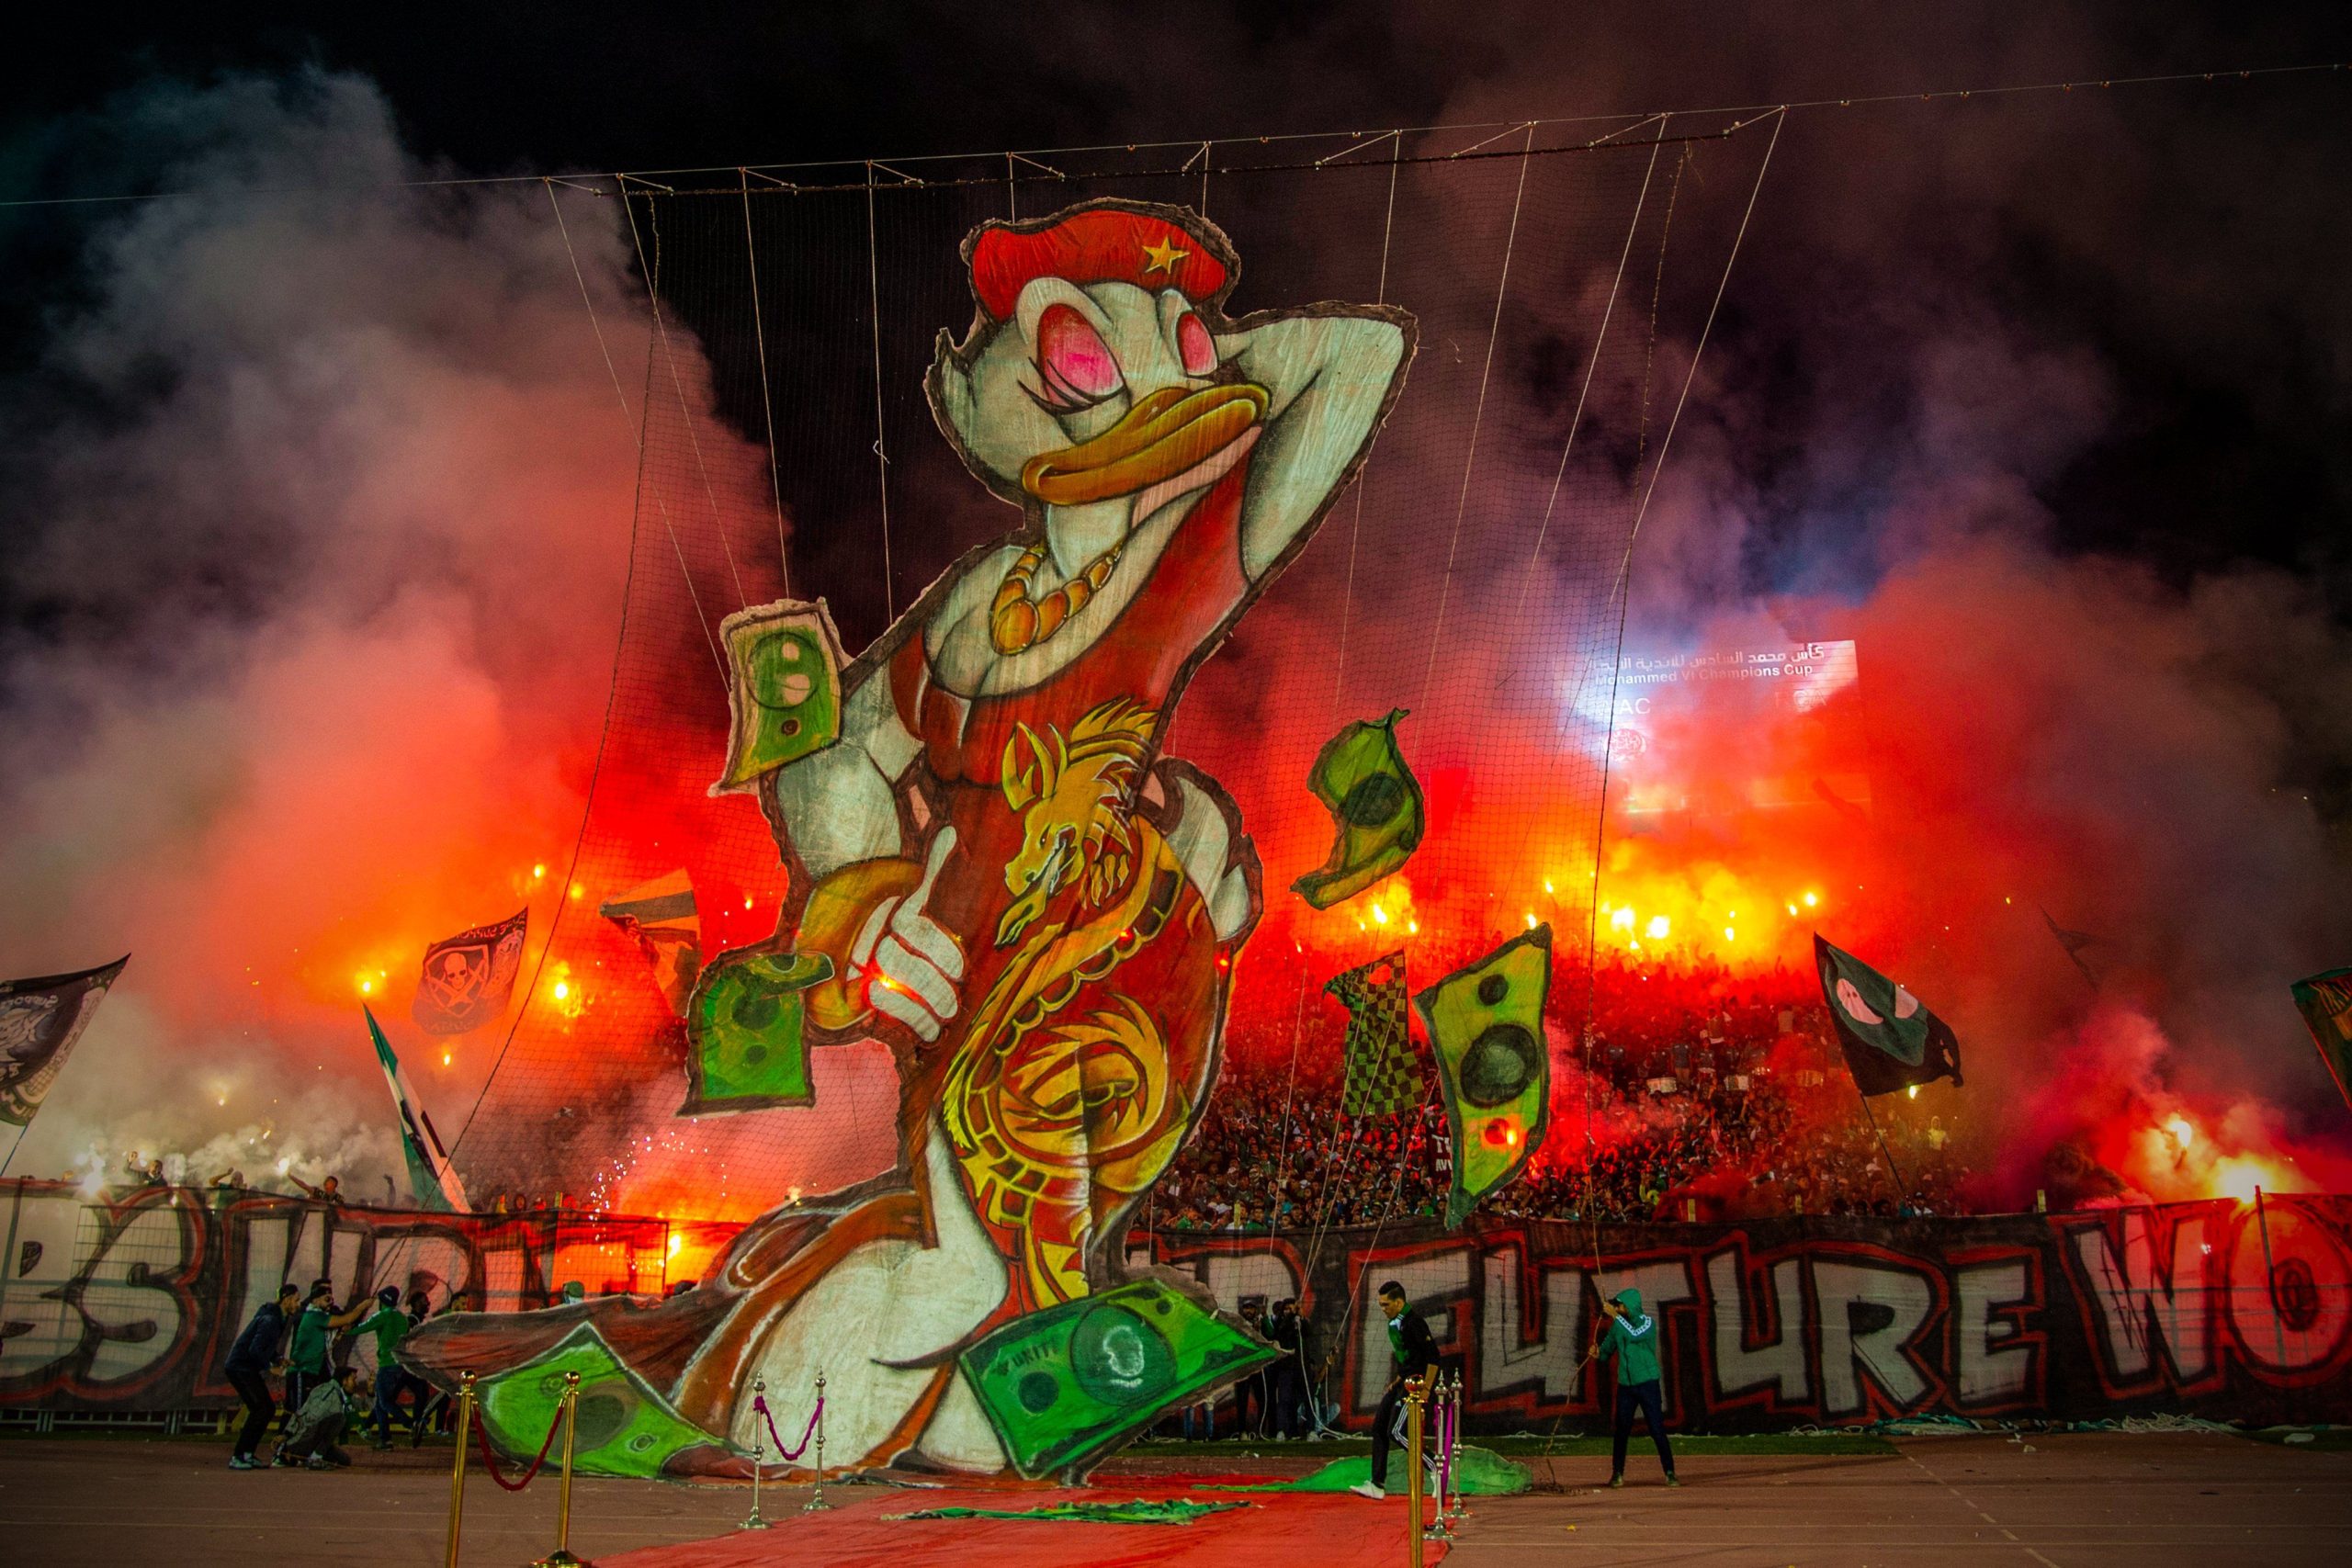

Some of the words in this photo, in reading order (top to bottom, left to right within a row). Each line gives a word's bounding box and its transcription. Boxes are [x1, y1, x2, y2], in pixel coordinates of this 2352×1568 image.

[1747, 652, 1786, 664] محمد
[1791, 643, 1824, 662] كأس
[1595, 671, 1677, 685] Mohammed
[1699, 666, 1780, 681] Champions
[1783, 664, 1813, 677] Cup
[1349, 1229, 2041, 1422] FUTURE
